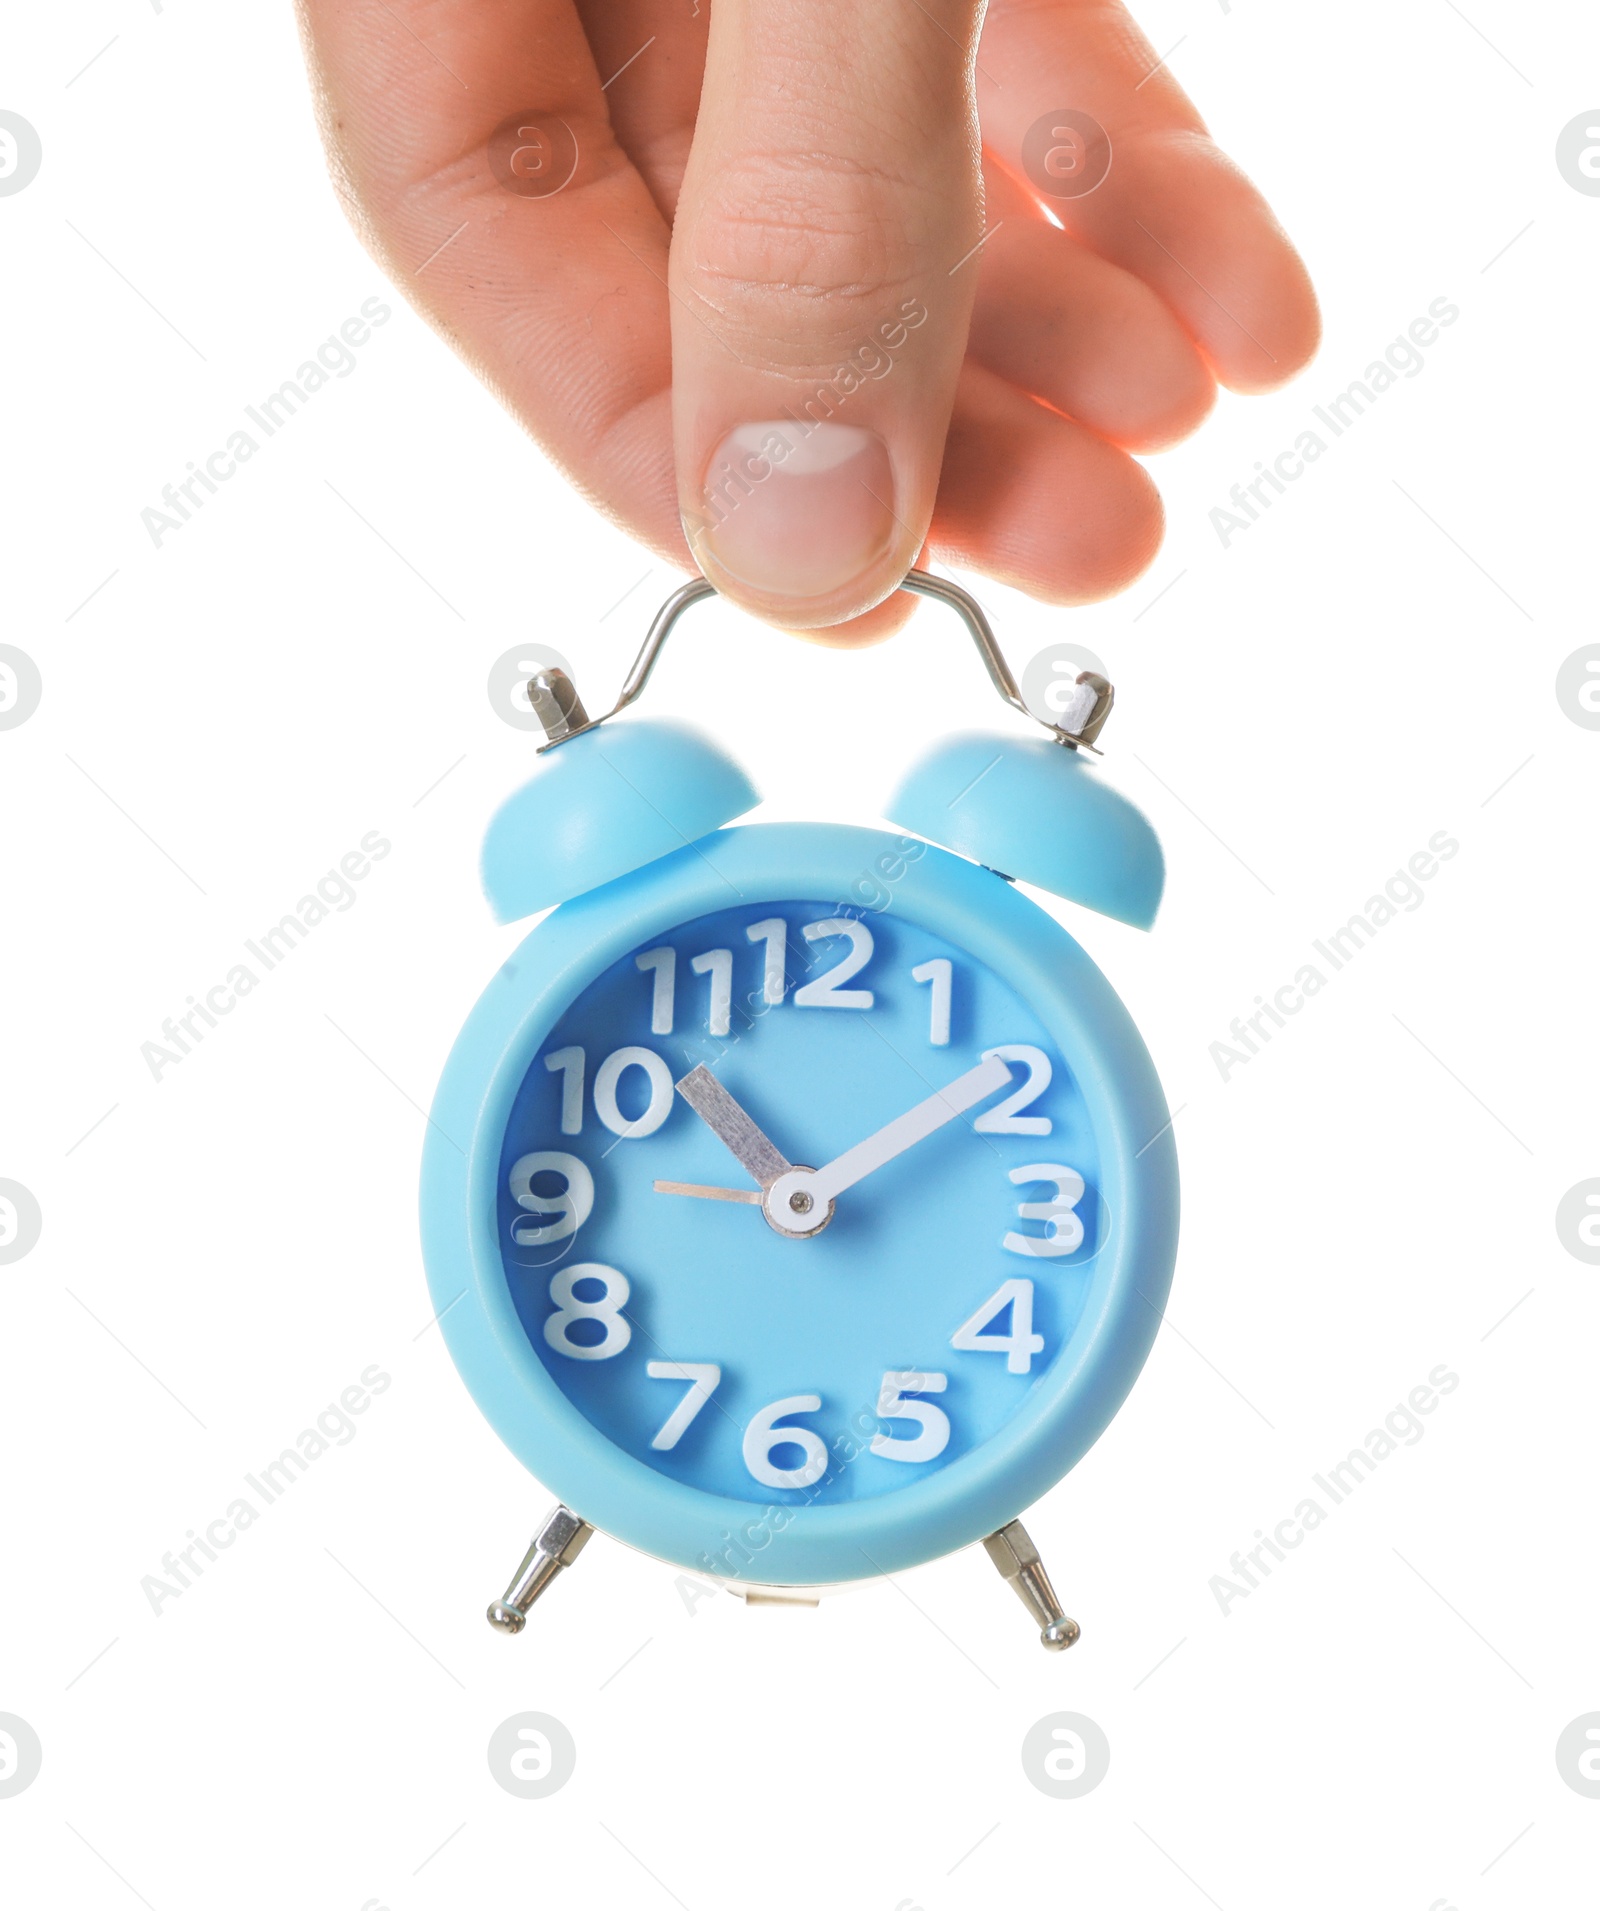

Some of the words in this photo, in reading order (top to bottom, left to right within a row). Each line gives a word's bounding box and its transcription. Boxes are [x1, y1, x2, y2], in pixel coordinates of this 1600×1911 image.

[635, 947, 733, 1036] 11
[747, 918, 874, 1009] 12
[912, 959, 952, 1045] 1
[543, 1045, 674, 1138] 10
[974, 1044, 1052, 1135] 2
[509, 1150, 595, 1246] 9
[1002, 1163, 1086, 1257] 3
[543, 1263, 631, 1360] 8
[951, 1279, 1044, 1374] 4
[647, 1360, 721, 1451] 7
[742, 1394, 829, 1488] 6
[870, 1370, 951, 1462] 5
